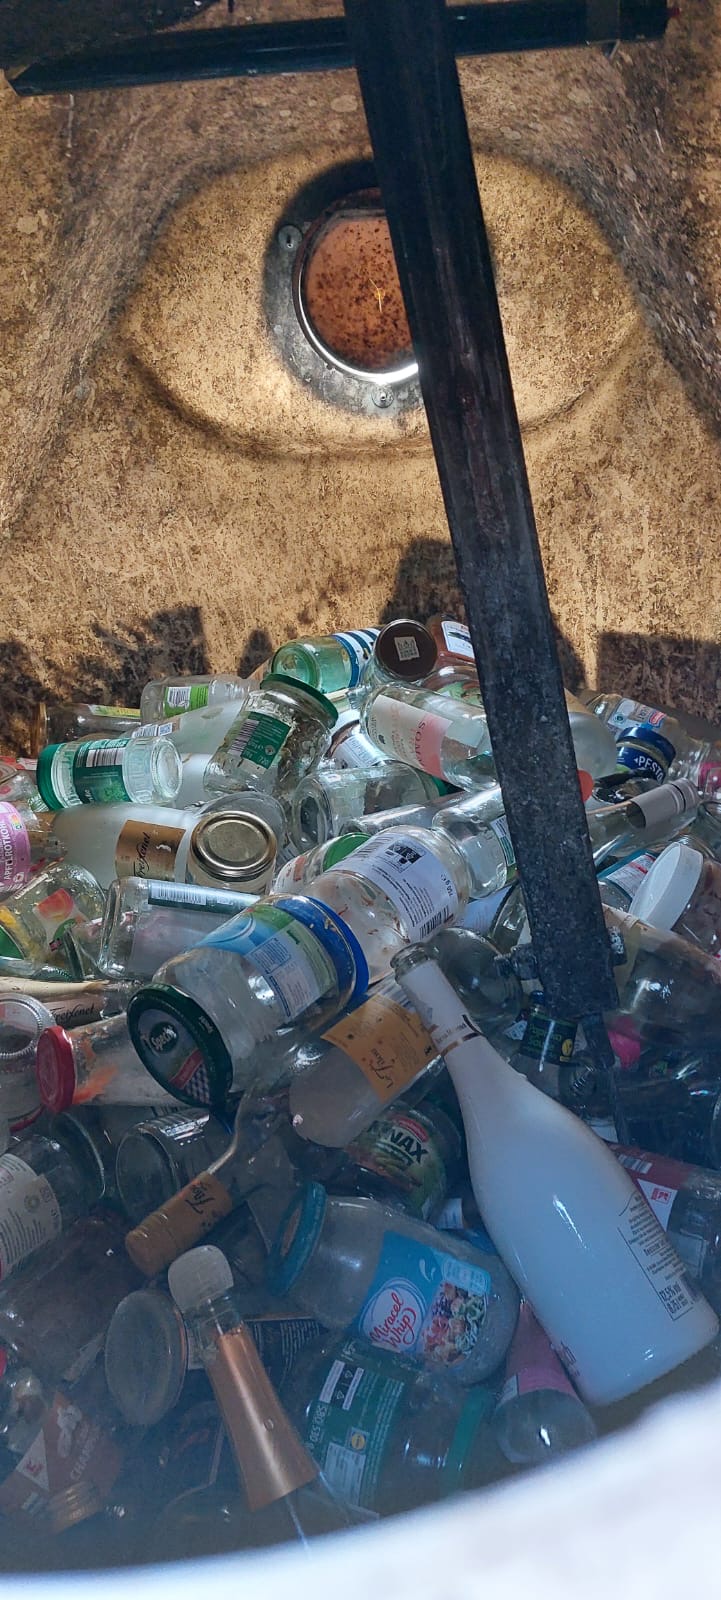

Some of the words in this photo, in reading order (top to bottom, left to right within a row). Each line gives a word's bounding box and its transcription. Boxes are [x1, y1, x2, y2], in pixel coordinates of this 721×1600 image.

[638, 754, 665, 781] PESTO
[370, 1293, 404, 1344] Miracel
[386, 1306, 418, 1349] Whip
